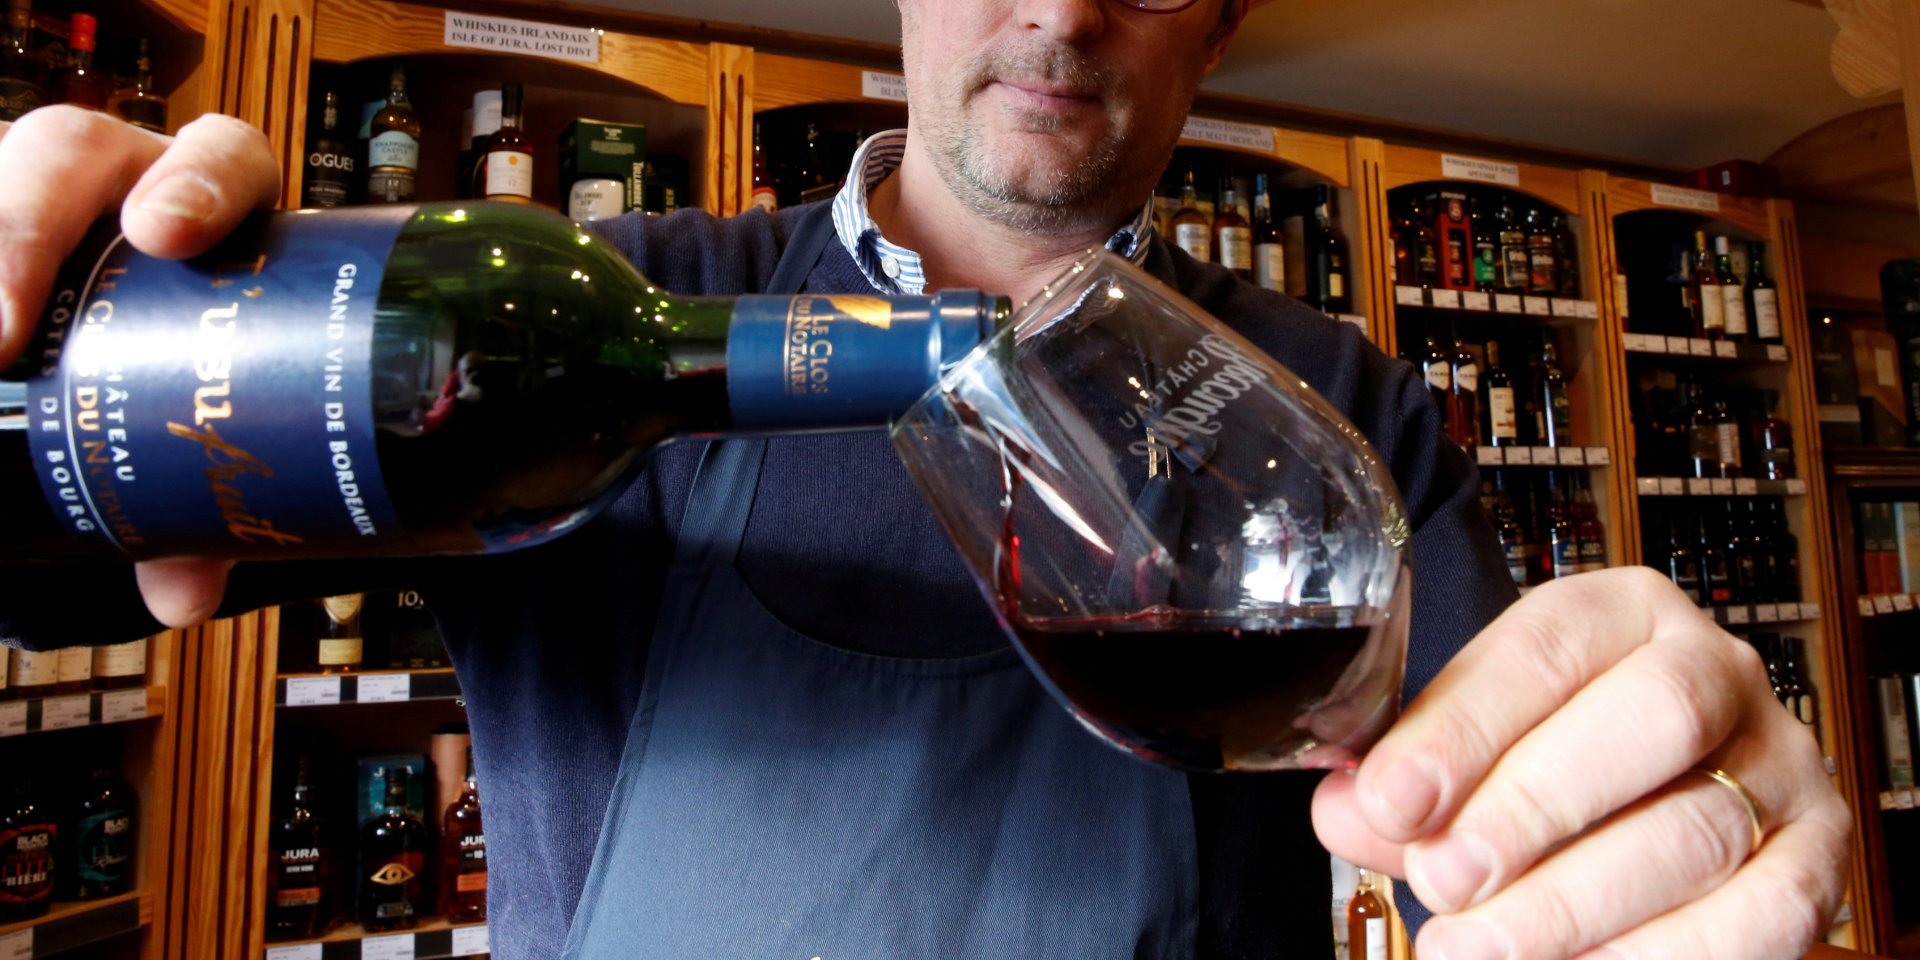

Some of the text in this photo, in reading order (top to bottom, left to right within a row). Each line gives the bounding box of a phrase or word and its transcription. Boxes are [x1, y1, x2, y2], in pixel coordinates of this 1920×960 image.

[453, 18, 590, 43] WHISKIES IRLANDAIS
[452, 32, 592, 57] ISLE OF JURA, LOST DIST
[871, 72, 907, 86] WHISK
[880, 86, 908, 98] BLEN
[309, 153, 354, 172] OGUES
[382, 147, 408, 155] CASTLE
[95, 267, 129, 294] LE
[76, 300, 114, 378] CLS
[790, 316, 812, 394] NOTAIRE
[810, 315, 834, 393] LE CLOS
[76, 386, 100, 432] DU
[324, 263, 377, 536] GRAND VIN DE BORDEAUX
[40, 397, 60, 432] DE
[105, 362, 137, 481] HÂTEAU
[46, 449, 95, 532] BOURG
[374, 765, 414, 777] JA
[103, 816, 130, 832] BLAC
[16, 832, 49, 846] BLACK
[460, 834, 486, 847] JUR
[280, 847, 320, 860] JURA
